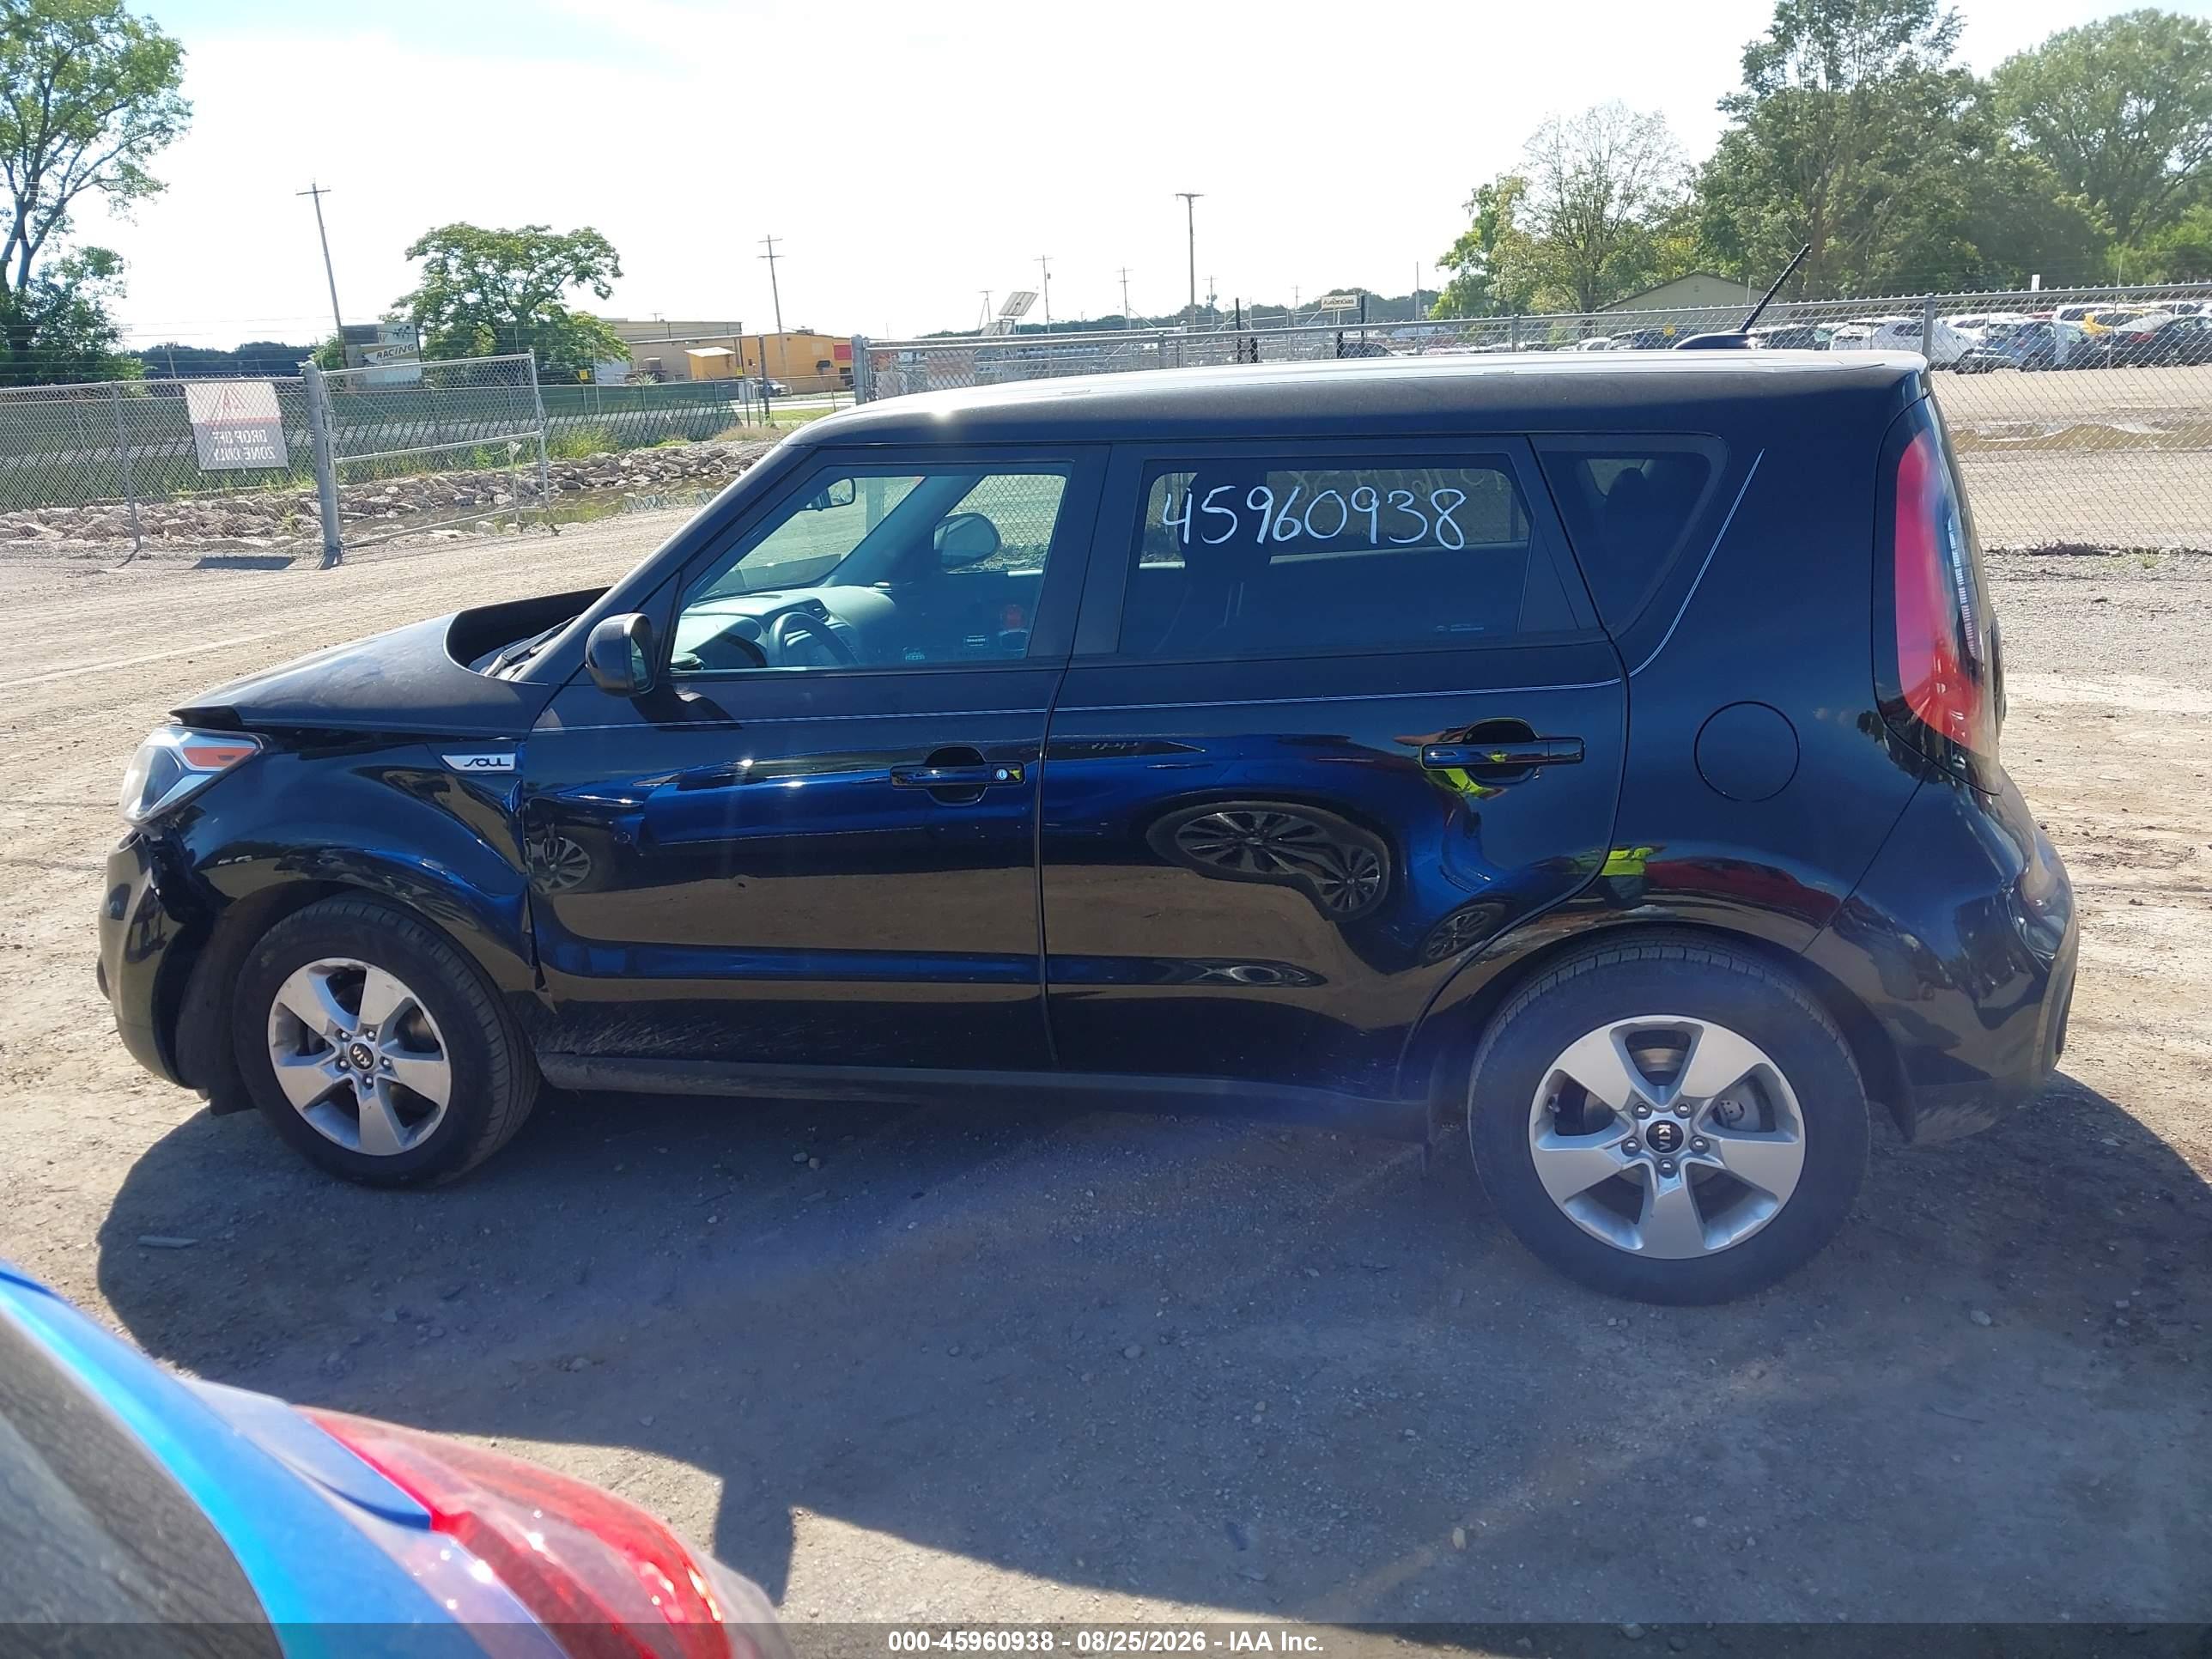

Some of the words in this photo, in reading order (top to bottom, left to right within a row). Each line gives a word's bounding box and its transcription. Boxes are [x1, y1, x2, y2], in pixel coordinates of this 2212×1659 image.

[376, 343, 414, 360] RACING
[1162, 485, 1467, 550] 45960938
[352, 1045, 370, 1066] KIA
[1658, 1124, 1671, 1151] KIA
